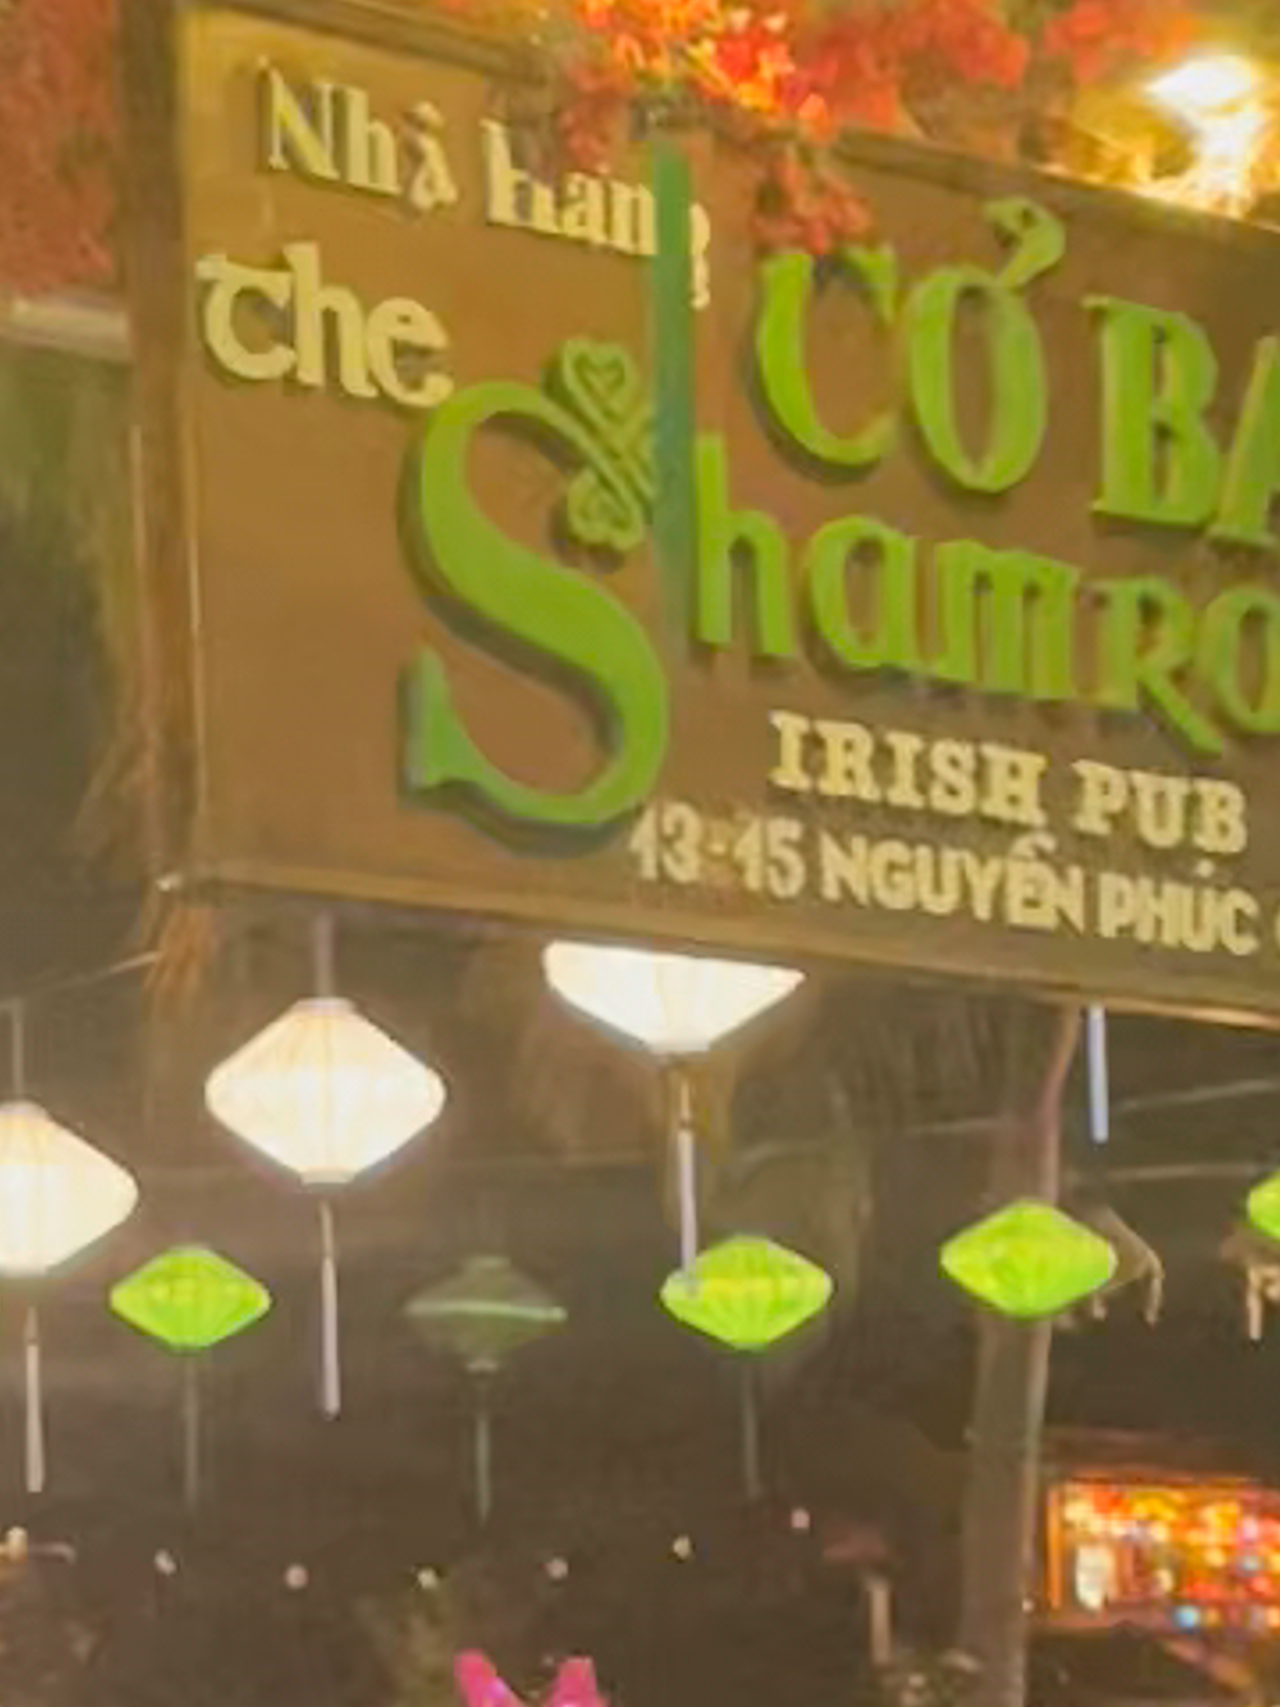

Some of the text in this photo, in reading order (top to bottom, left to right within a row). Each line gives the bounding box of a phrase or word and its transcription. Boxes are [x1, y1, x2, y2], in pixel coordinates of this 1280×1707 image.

[256, 57, 458, 211] Nhà
[770, 709, 1250, 853] IRISH PUB
[629, 802, 808, 897] 13-15
[1098, 859, 1262, 957] PHÚC
